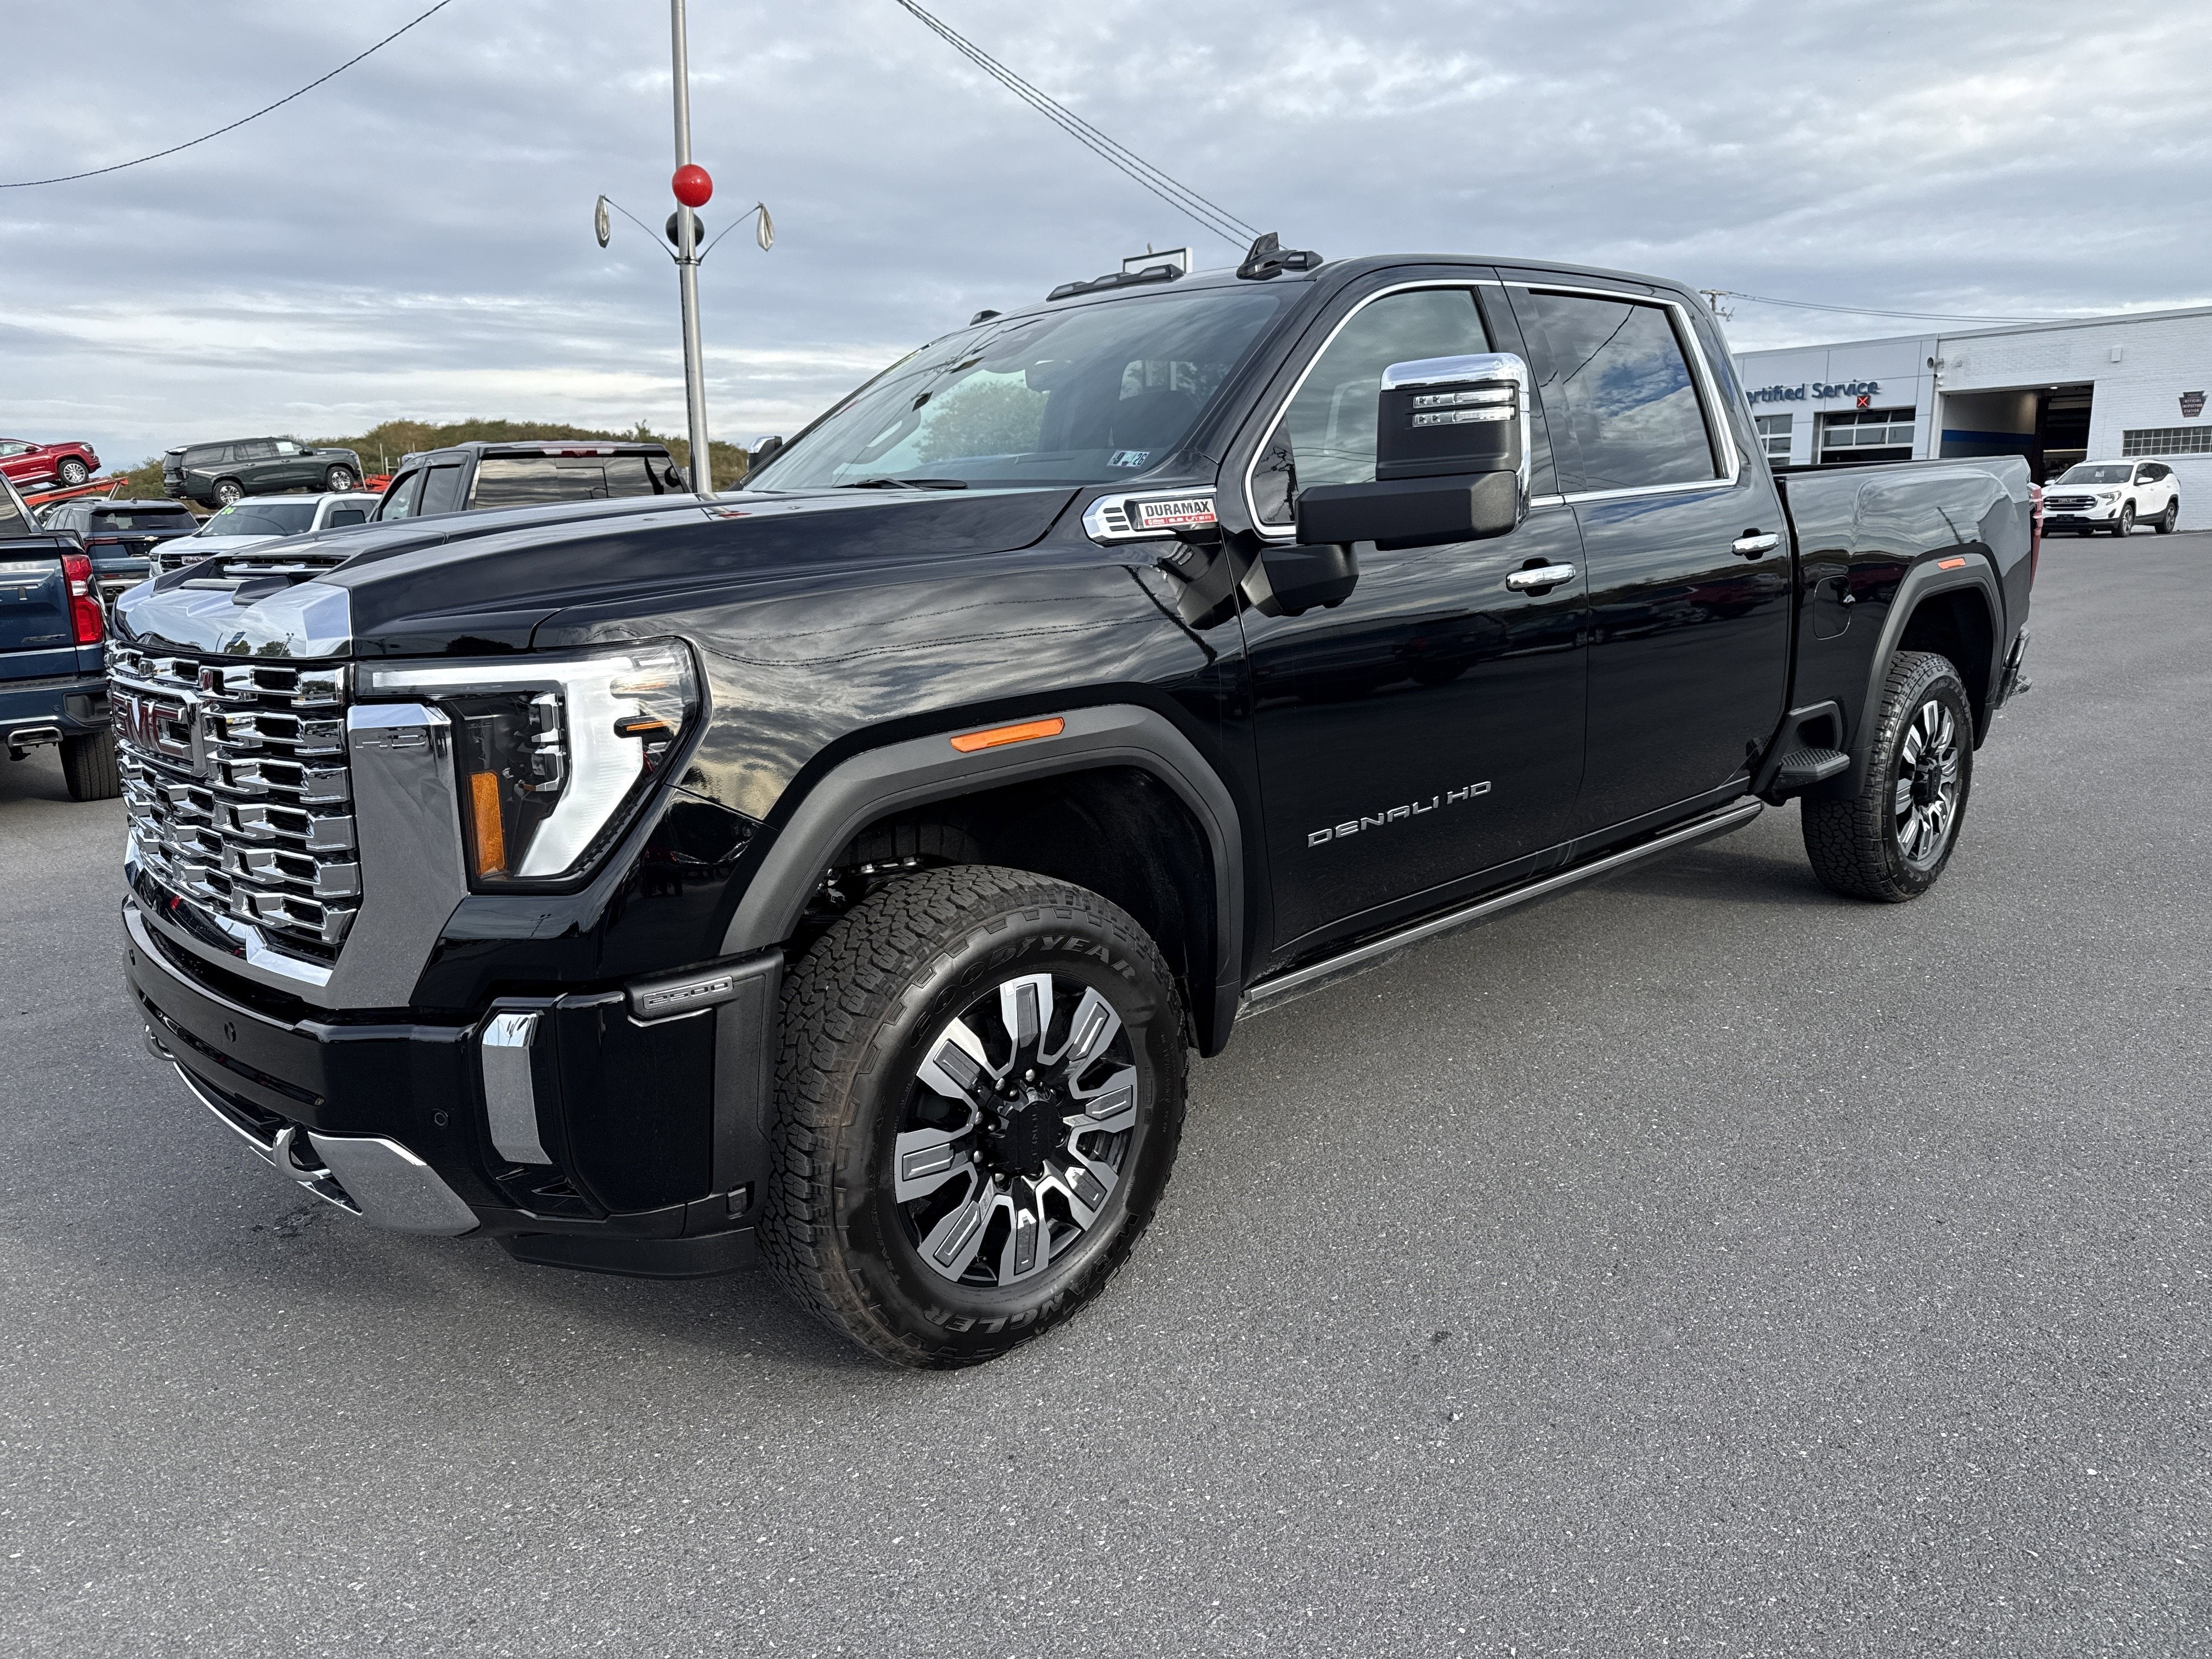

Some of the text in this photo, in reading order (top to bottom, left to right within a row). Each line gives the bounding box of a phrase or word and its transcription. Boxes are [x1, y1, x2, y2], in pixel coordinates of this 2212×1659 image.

[1746, 379, 1879, 404] ertified Service
[1132, 453, 1148, 465] 26
[1145, 501, 1210, 517] DURAMAX
[111, 690, 193, 761] GMC
[1308, 781, 1491, 848] DENALI HD
[648, 982, 729, 1006] 2500
[910, 935, 1136, 1048] GOODYEAR
[923, 1212, 1141, 1334] WRANGLER
